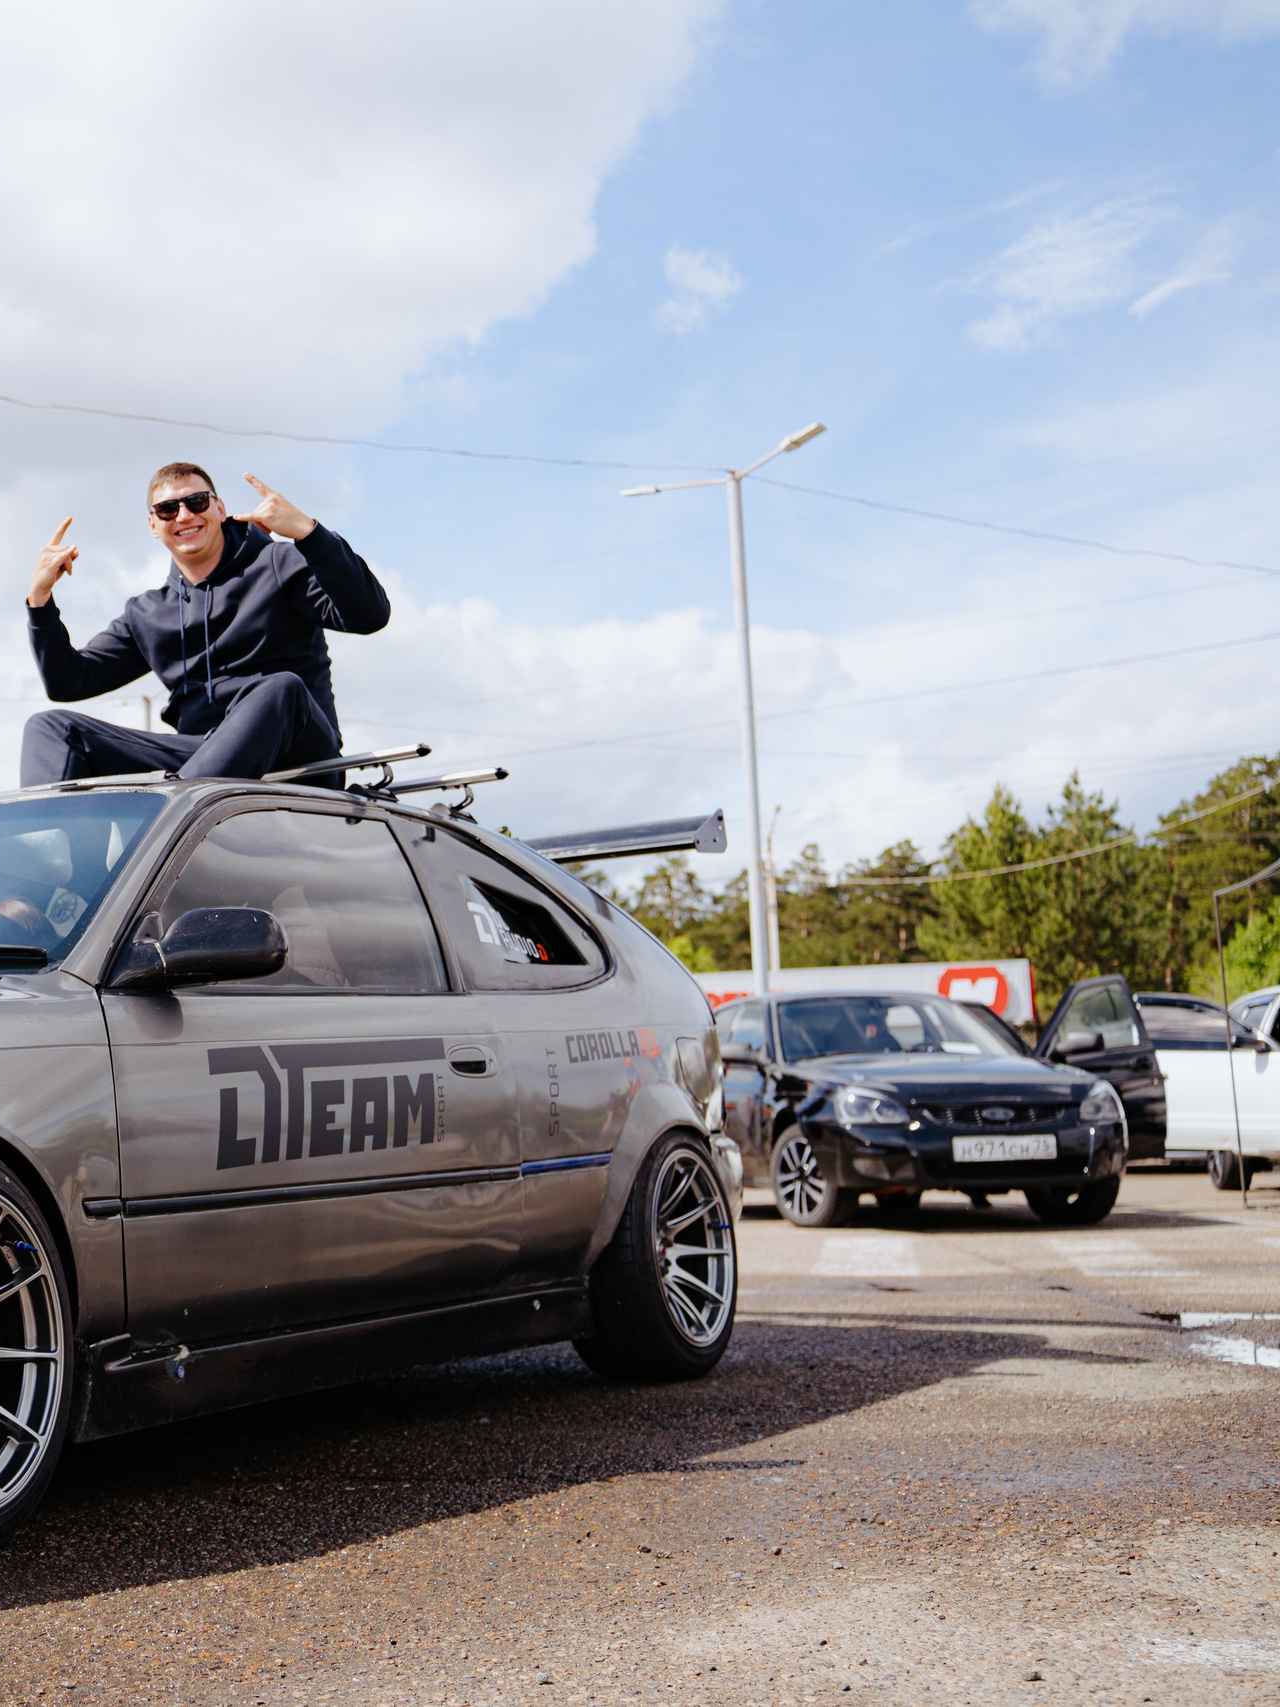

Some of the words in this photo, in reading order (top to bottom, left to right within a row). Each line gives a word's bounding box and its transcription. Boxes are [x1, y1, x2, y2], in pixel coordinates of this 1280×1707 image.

[565, 1030, 641, 1064] COROLLA
[436, 1072, 445, 1142] SPORT
[546, 1046, 560, 1137] SPORT
